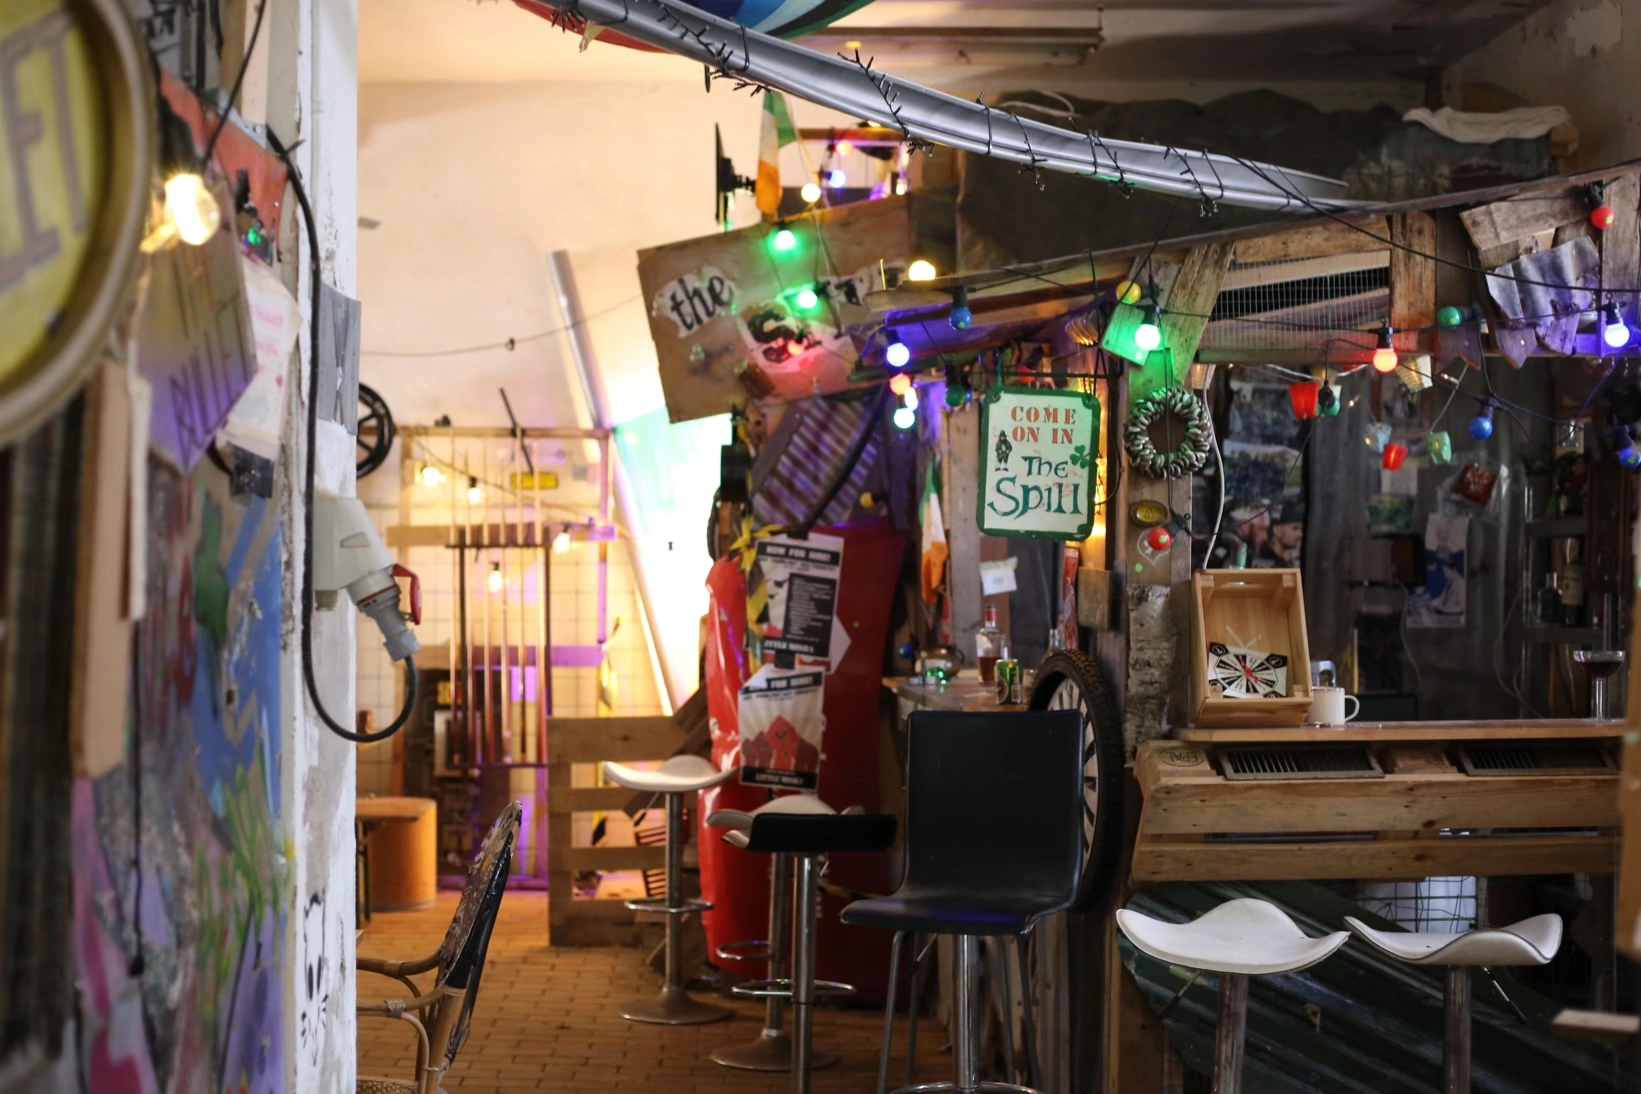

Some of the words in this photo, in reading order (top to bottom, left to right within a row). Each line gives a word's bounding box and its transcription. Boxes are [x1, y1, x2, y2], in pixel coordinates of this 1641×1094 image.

[669, 275, 734, 332] the
[1011, 406, 1076, 425] COME
[1012, 426, 1040, 443] ON
[1051, 428, 1074, 444] IN
[1021, 456, 1068, 478] The
[987, 474, 1083, 520] Spill
